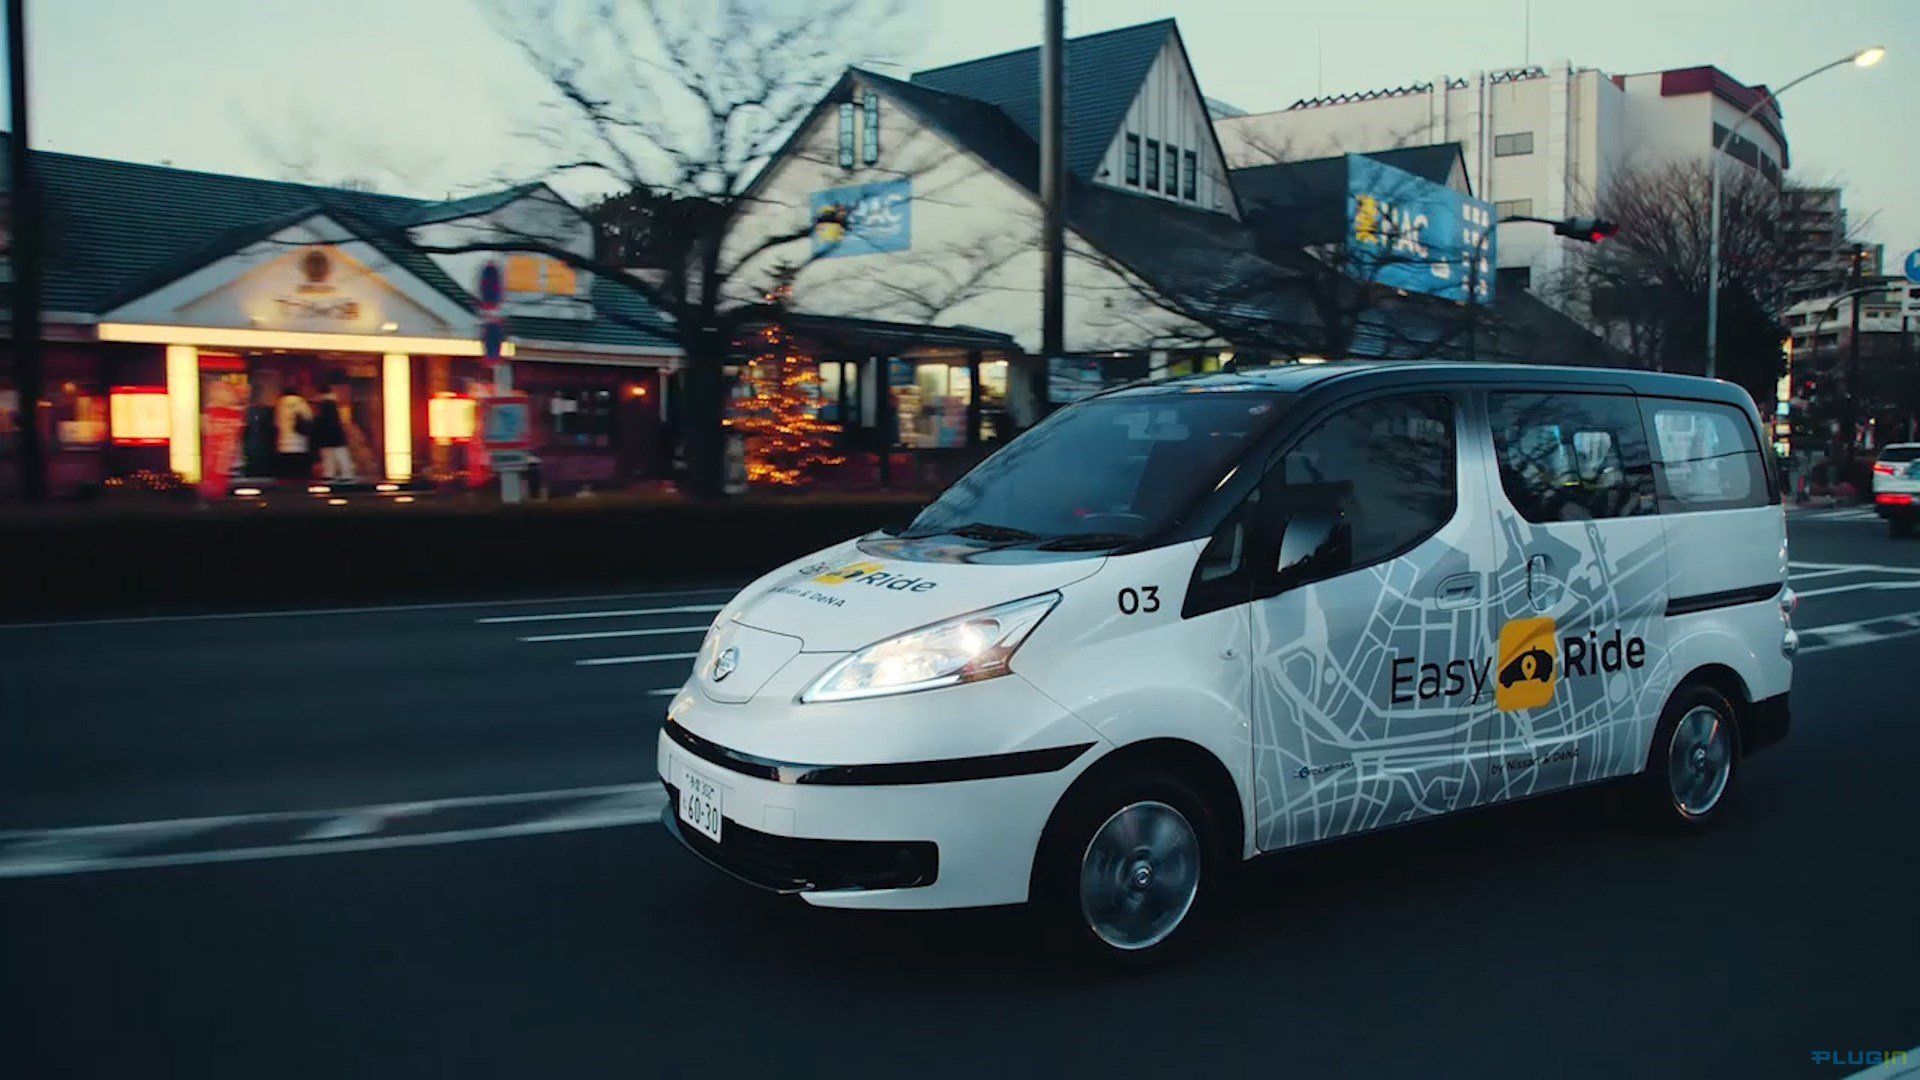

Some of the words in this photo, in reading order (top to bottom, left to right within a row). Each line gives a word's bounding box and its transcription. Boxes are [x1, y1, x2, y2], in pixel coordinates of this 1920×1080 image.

[857, 571, 938, 593] Ride
[1118, 585, 1160, 615] 03
[1391, 656, 1493, 705] Easy
[1563, 629, 1646, 679] Ride
